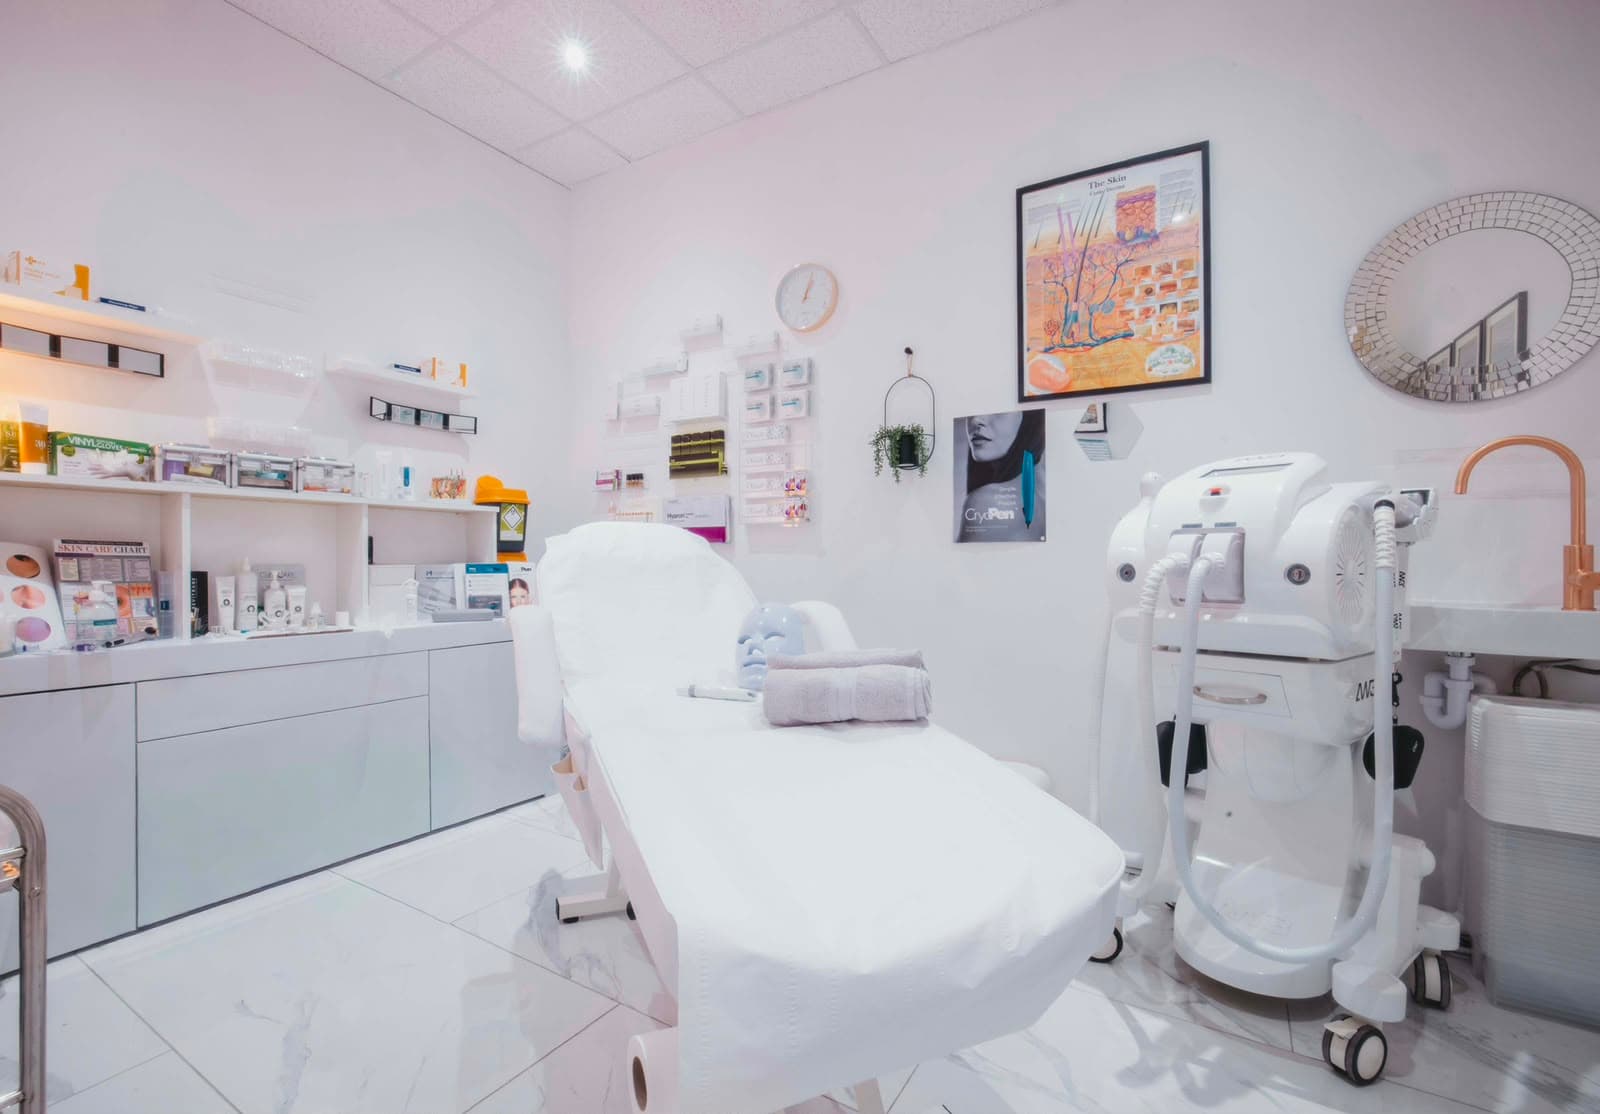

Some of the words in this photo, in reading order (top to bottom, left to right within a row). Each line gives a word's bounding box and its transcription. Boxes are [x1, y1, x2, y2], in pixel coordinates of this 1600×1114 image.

[1088, 181, 1104, 190] The
[1107, 174, 1127, 185] Skin
[68, 435, 97, 447] VINYL
[965, 507, 1015, 524] CryoPen
[58, 544, 83, 553] SKIN
[86, 546, 113, 554] CARE
[114, 546, 147, 555] CHART
